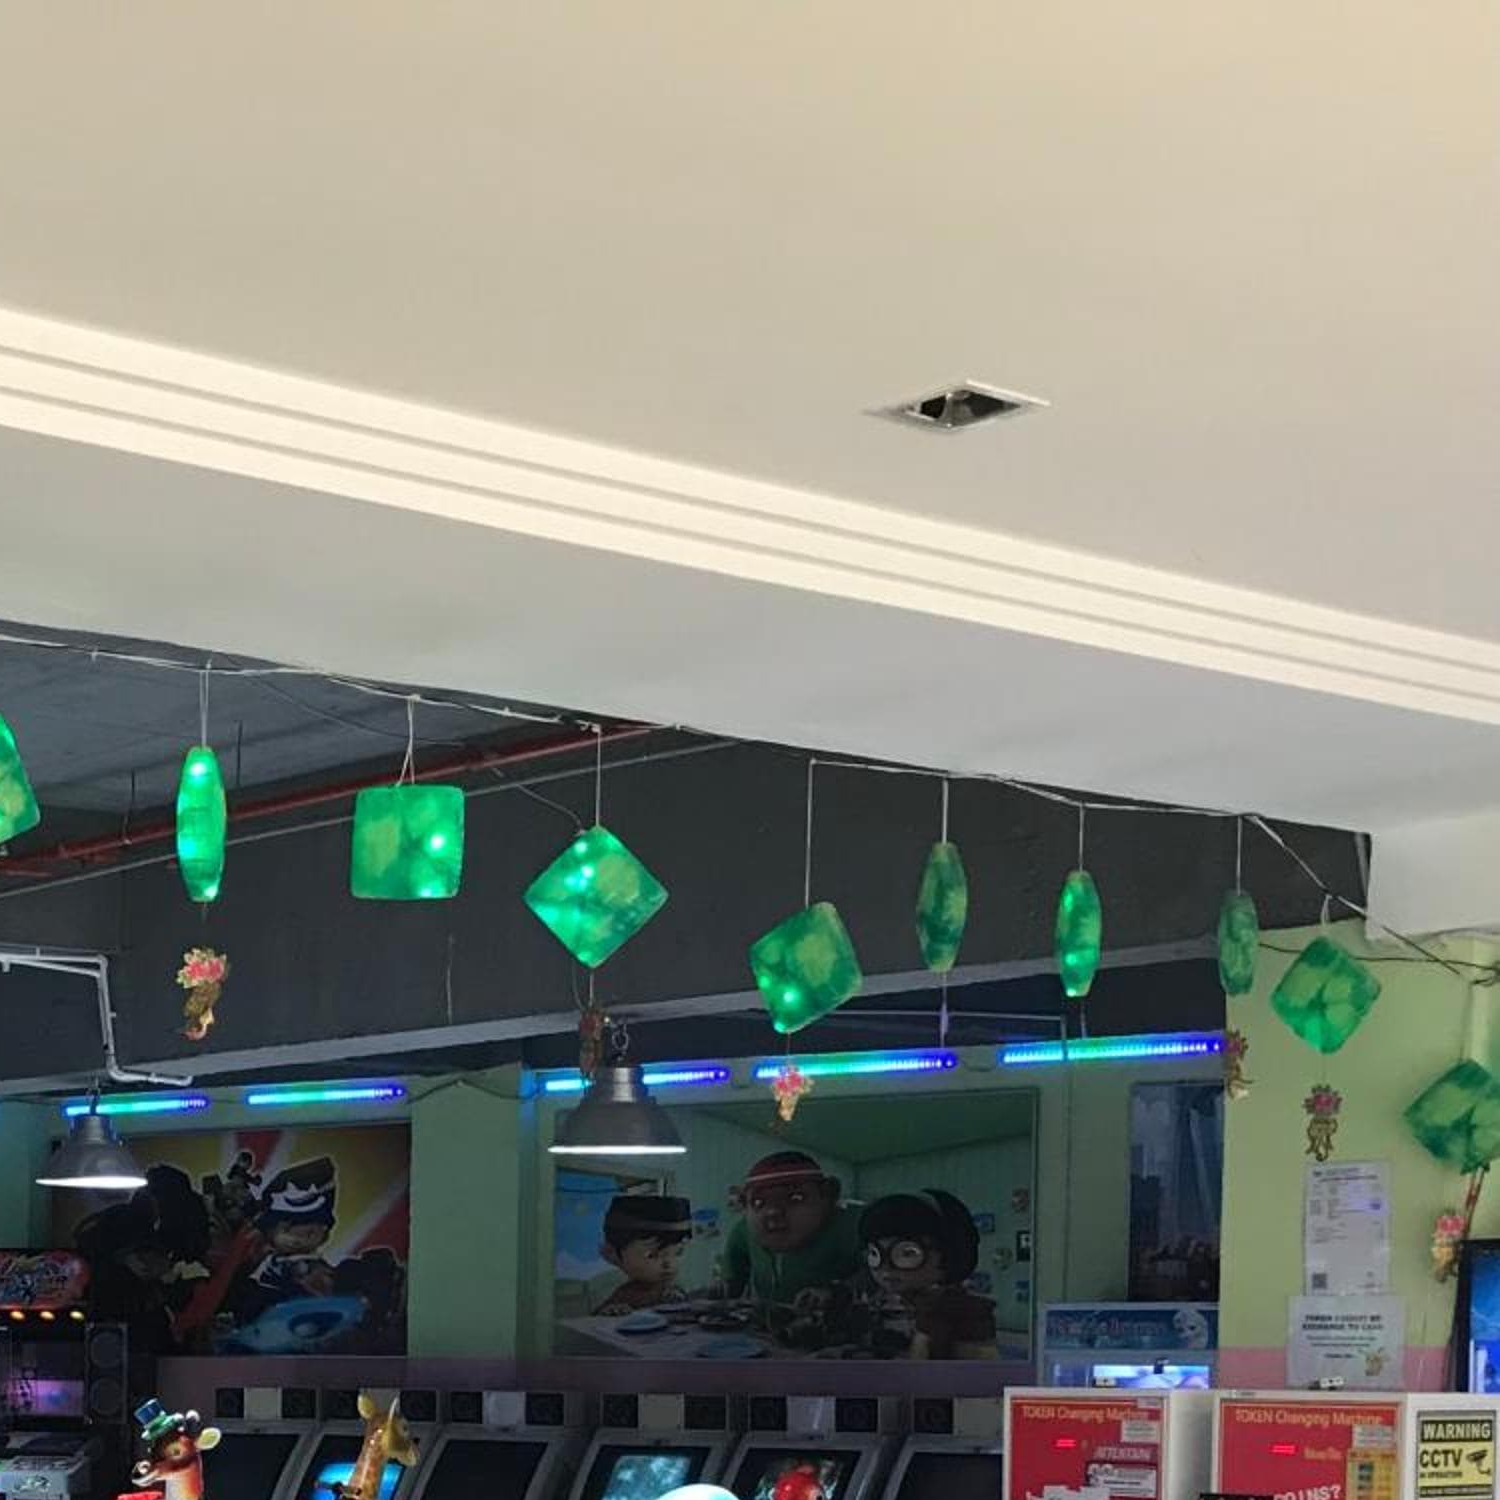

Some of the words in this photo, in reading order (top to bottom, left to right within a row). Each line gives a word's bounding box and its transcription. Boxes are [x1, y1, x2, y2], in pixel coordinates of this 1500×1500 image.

[1236, 1409, 1272, 1423] TOKEN
[1276, 1411, 1330, 1428] Changing
[1423, 1423, 1491, 1440] WARNING
[1420, 1448, 1462, 1468] CCTV
